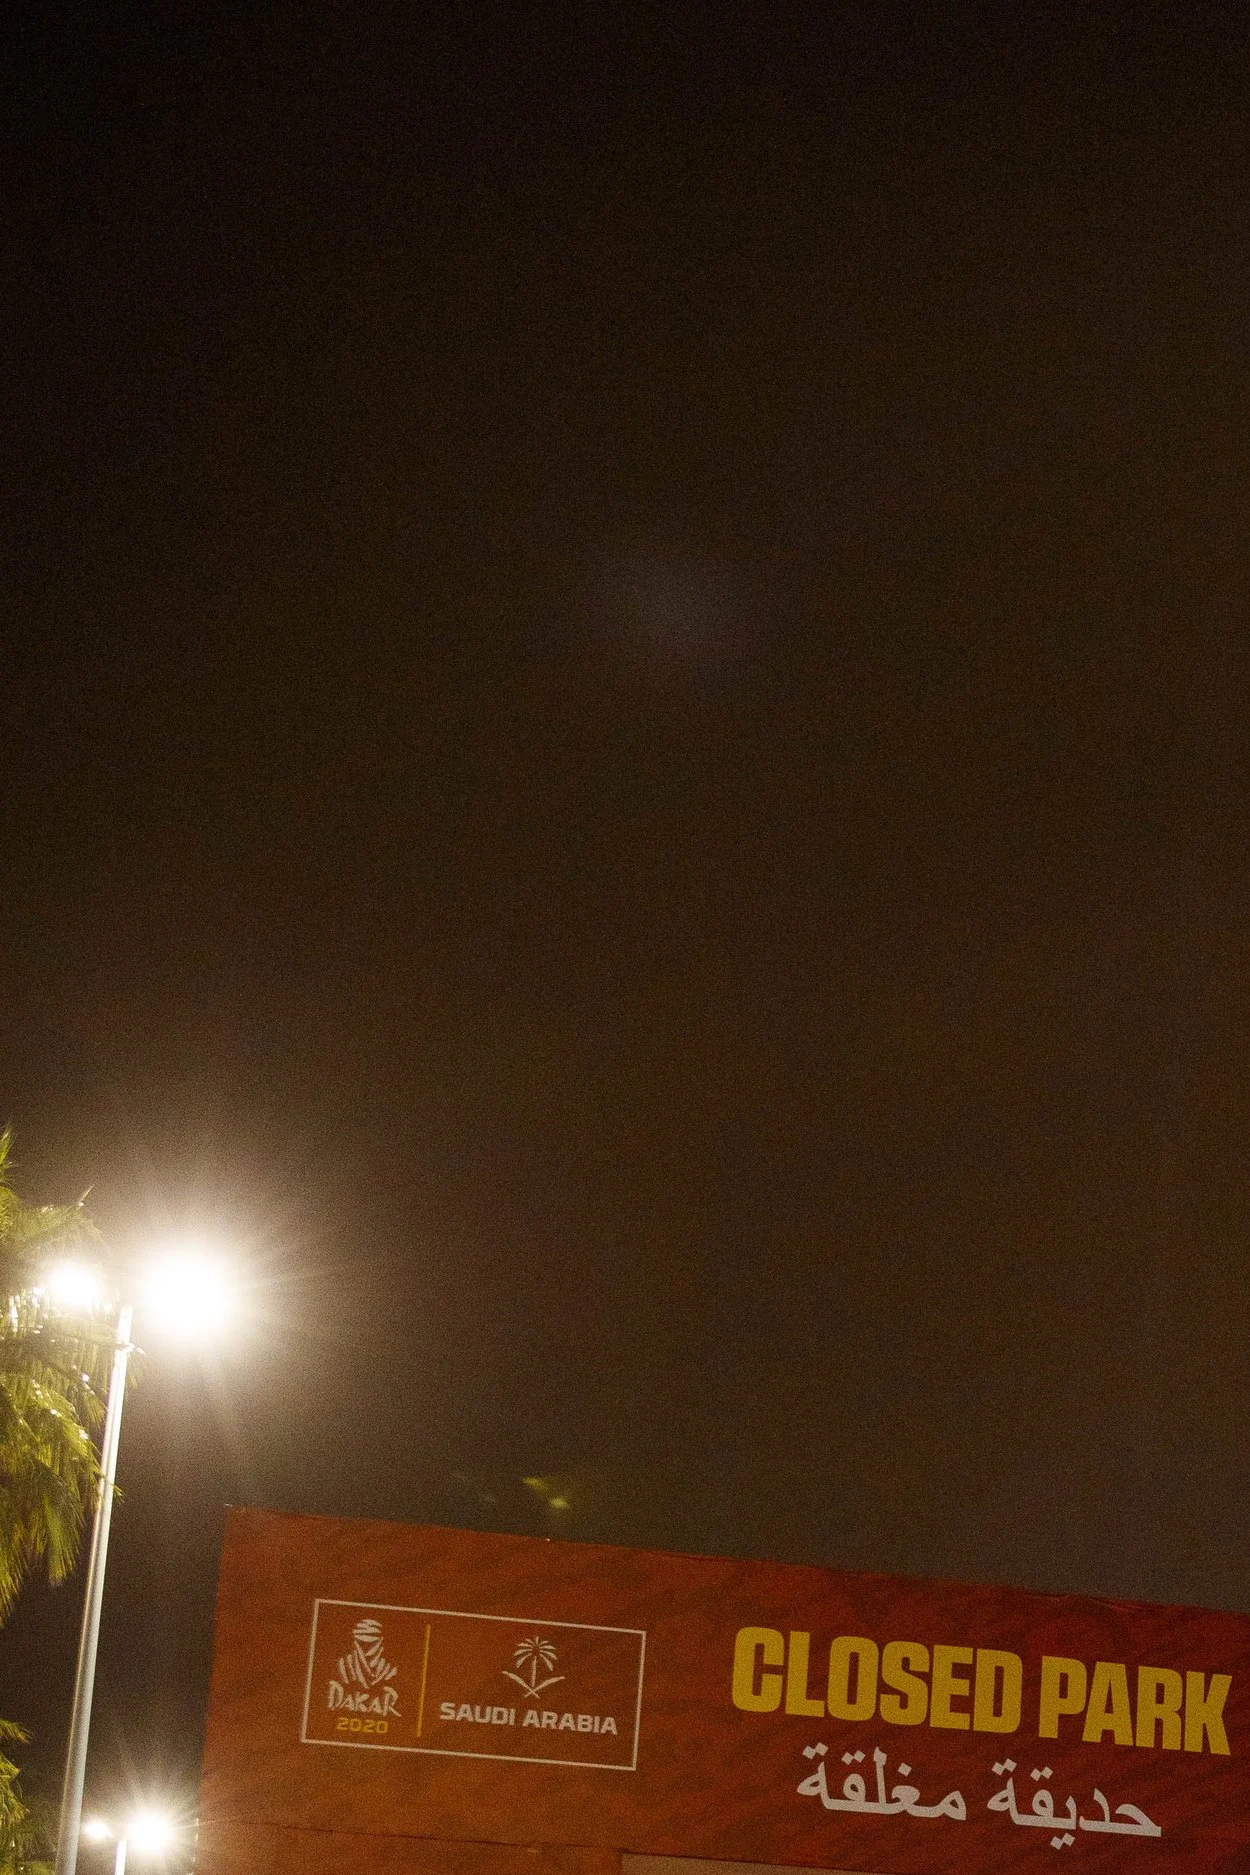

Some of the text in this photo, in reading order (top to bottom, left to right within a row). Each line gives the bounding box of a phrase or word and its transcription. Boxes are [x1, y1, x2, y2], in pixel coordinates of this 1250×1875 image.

[328, 1680, 401, 1719] DAKAR
[731, 1626, 1233, 1756] CLOSED PARK
[337, 1716, 389, 1735] 2020
[440, 1701, 618, 1736] SAUDI ARABIA
[797, 1742, 1162, 1850] حديقة مغلقة
